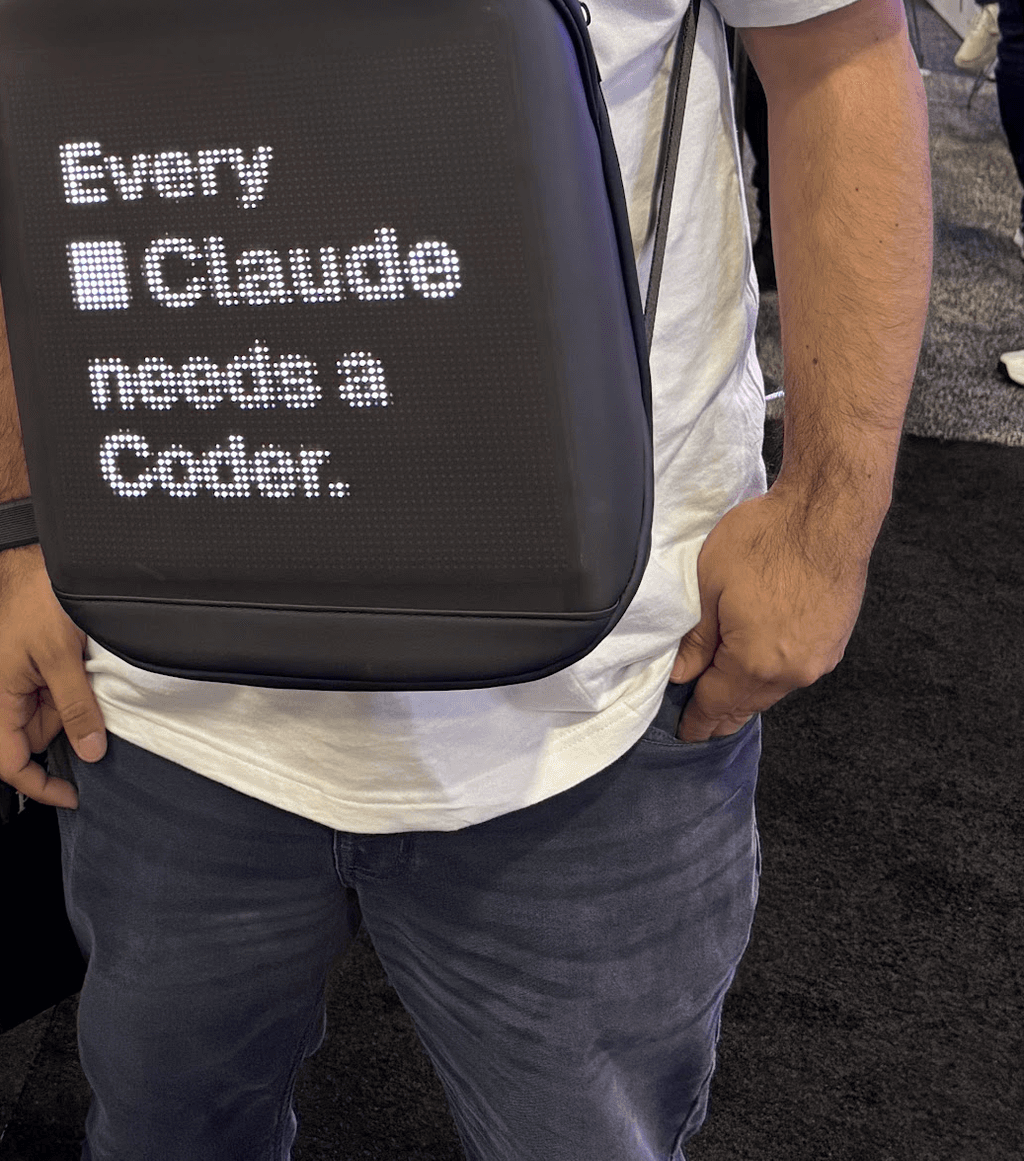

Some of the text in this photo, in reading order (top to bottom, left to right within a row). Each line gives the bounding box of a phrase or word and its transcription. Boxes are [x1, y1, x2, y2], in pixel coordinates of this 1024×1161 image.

[59, 141, 274, 210] Every
[141, 227, 463, 308] Claude
[87, 338, 394, 411] needs a
[98, 428, 351, 499] Coder.
